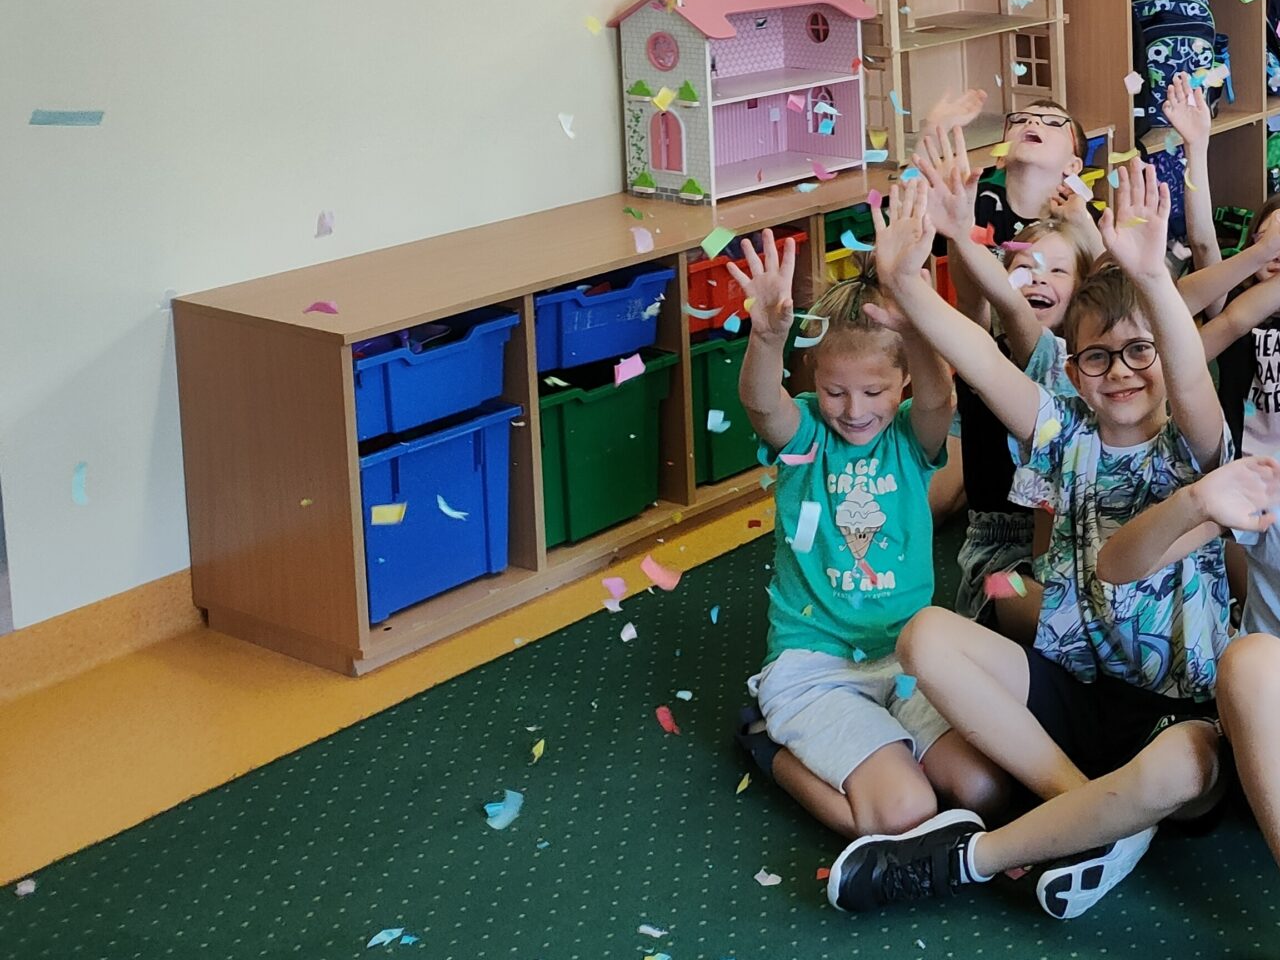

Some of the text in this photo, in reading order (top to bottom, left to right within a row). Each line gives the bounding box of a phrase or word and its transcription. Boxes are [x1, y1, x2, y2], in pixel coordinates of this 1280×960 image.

[845, 458, 879, 476] ICE
[827, 474, 897, 495] CREAM
[826, 567, 896, 591] TEAM
